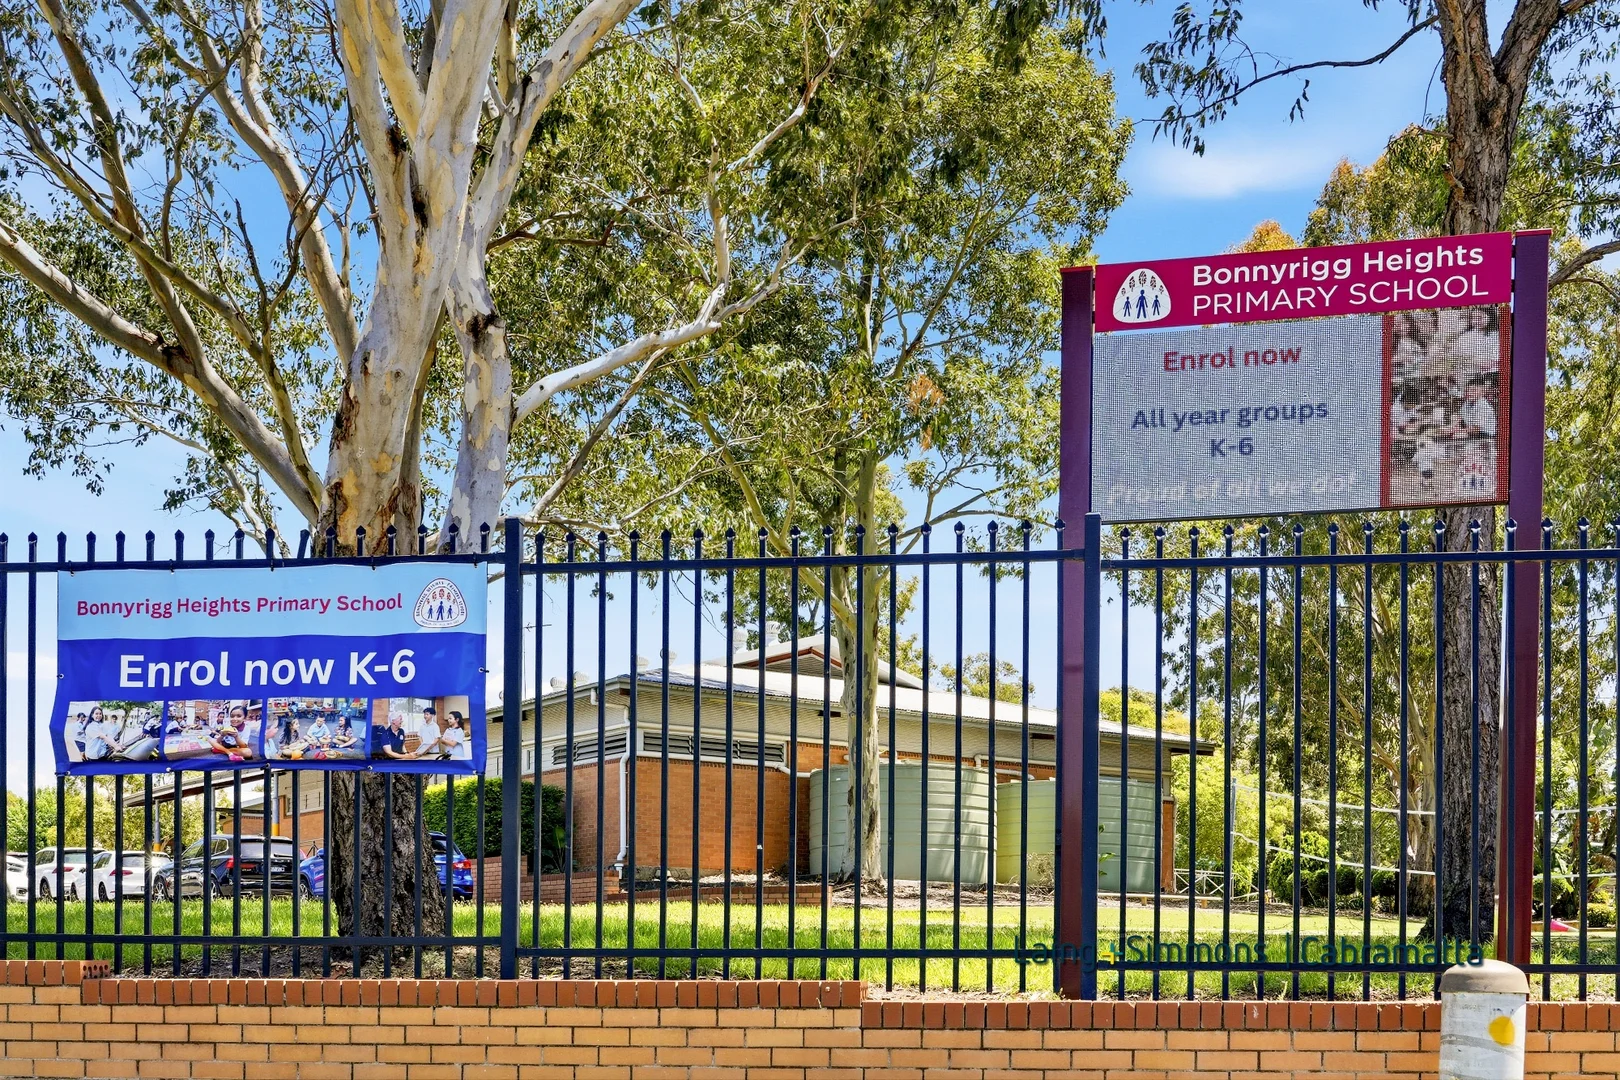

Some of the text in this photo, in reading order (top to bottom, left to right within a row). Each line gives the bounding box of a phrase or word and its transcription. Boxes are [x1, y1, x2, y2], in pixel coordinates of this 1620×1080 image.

[1193, 245, 1484, 287] Bonnyrigg Heights
[1193, 274, 1489, 317] PRIMARY SCHOOL
[1163, 345, 1302, 372] Enrol now
[1131, 402, 1329, 432] All year groups
[1210, 437, 1254, 458] K-6
[76, 592, 403, 619] Bonnyrigg Heights Primary School
[119, 648, 416, 688] Enrol now K-6
